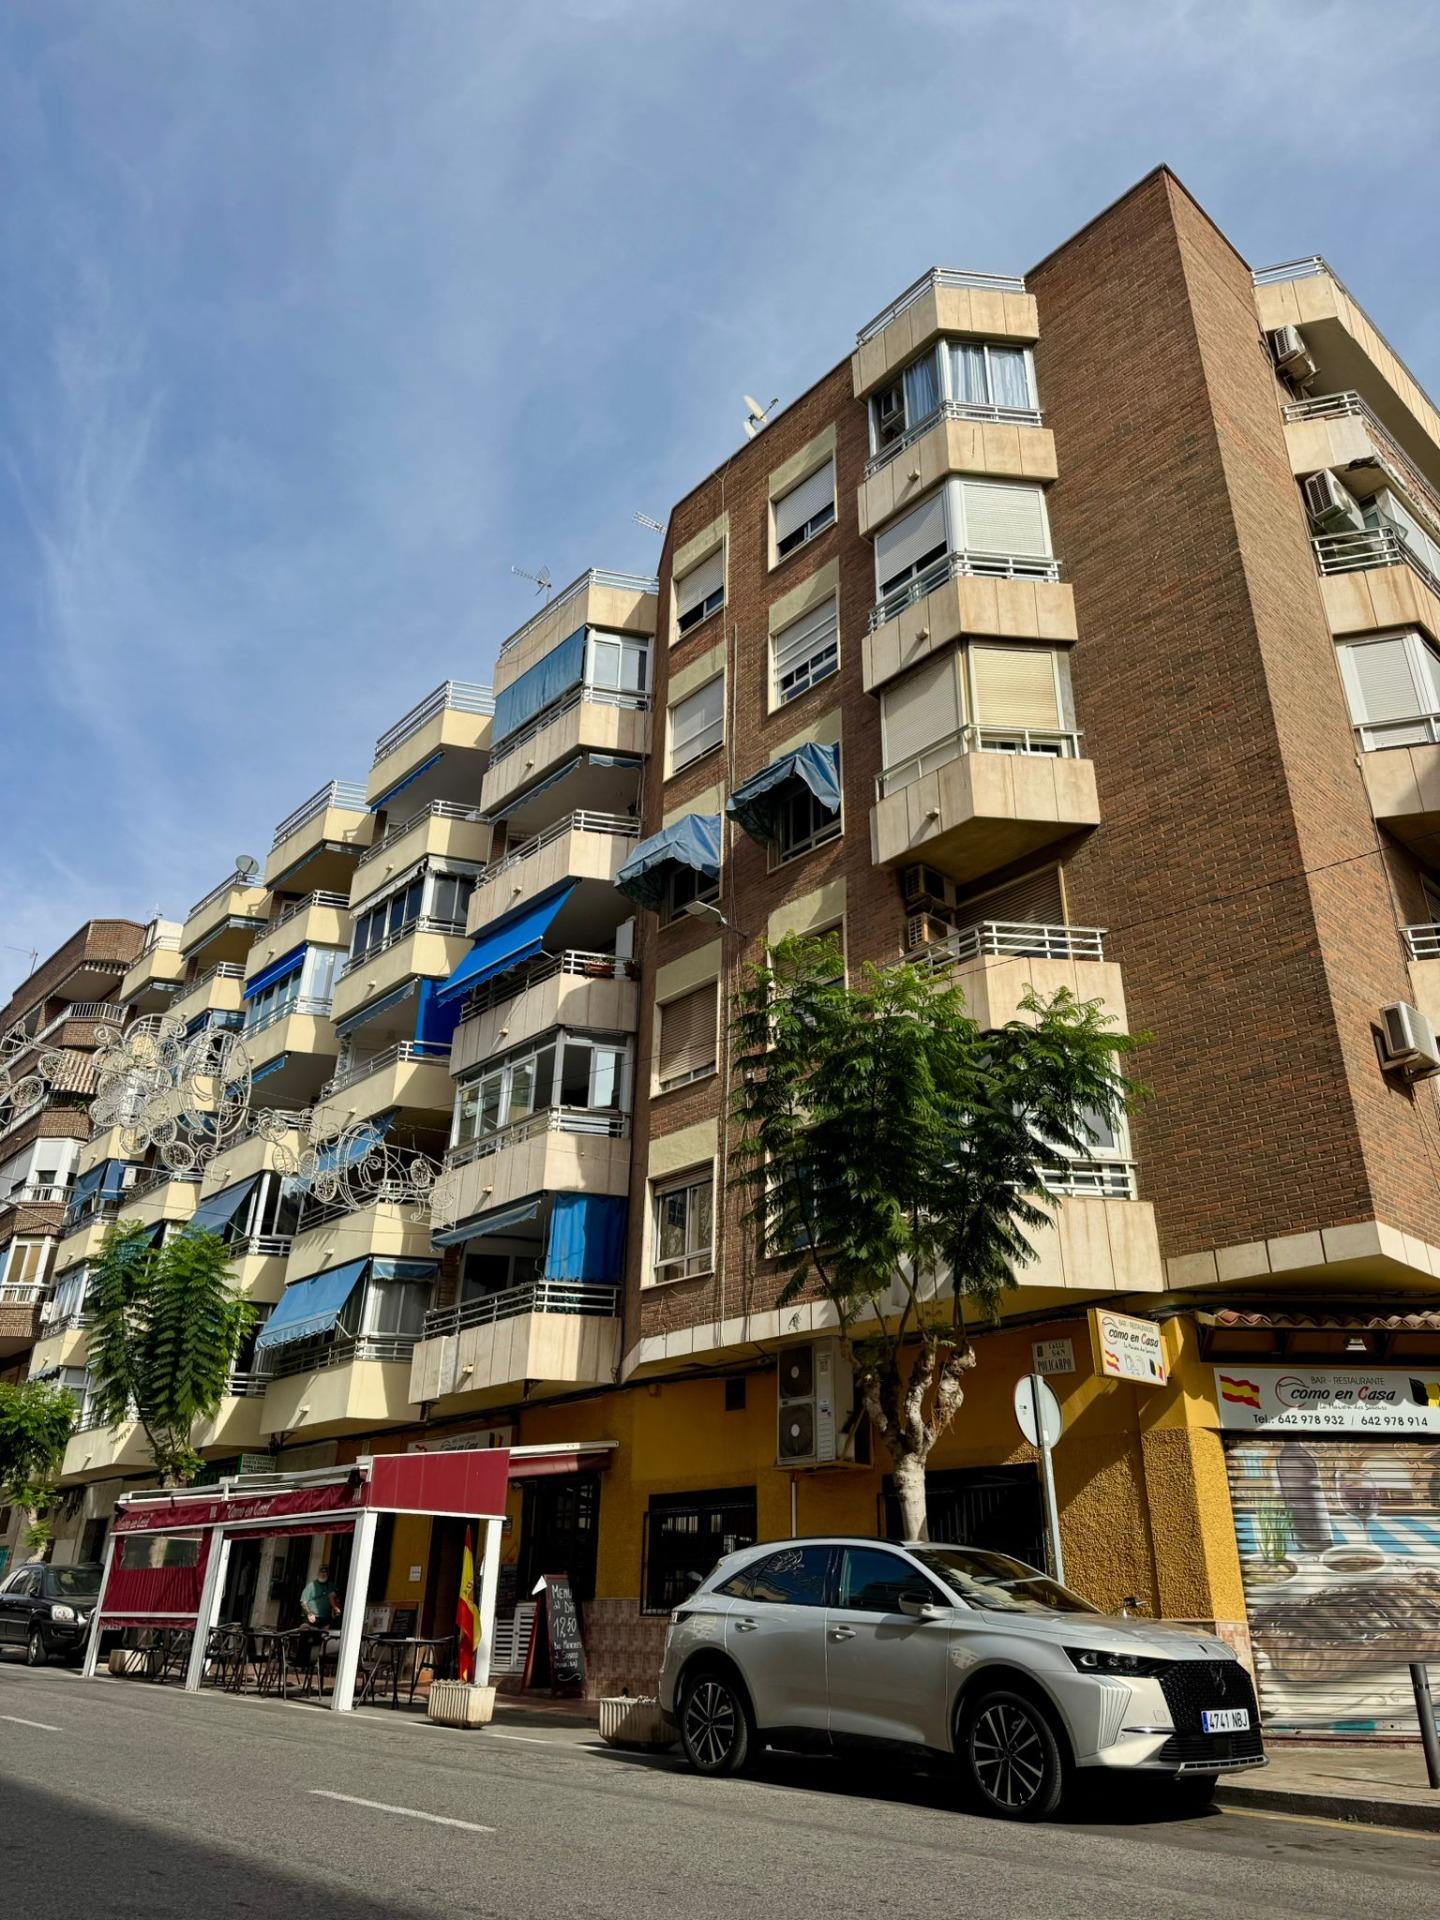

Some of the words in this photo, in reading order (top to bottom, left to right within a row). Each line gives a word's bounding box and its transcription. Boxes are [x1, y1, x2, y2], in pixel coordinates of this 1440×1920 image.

[1108, 1328, 1129, 1341] como
[1130, 1334, 1140, 1344] en
[1141, 1332, 1159, 1348] Casa
[1310, 1376, 1328, 1385] BAR
[1332, 1376, 1386, 1386] RESTAURANTE
[1290, 1388, 1331, 1400] como
[1334, 1390, 1354, 1400] en
[1357, 1385, 1397, 1401] Casa
[1277, 1414, 1298, 1424] 642
[1300, 1415, 1321, 1425] 978
[1323, 1415, 1345, 1425] 932
[1360, 1415, 1382, 1426] 642
[1383, 1416, 1405, 1426] 978
[1407, 1416, 1428, 1427] 914
[1209, 1712, 1230, 1729] 4741
[1231, 1711, 1248, 1728] NBJ
